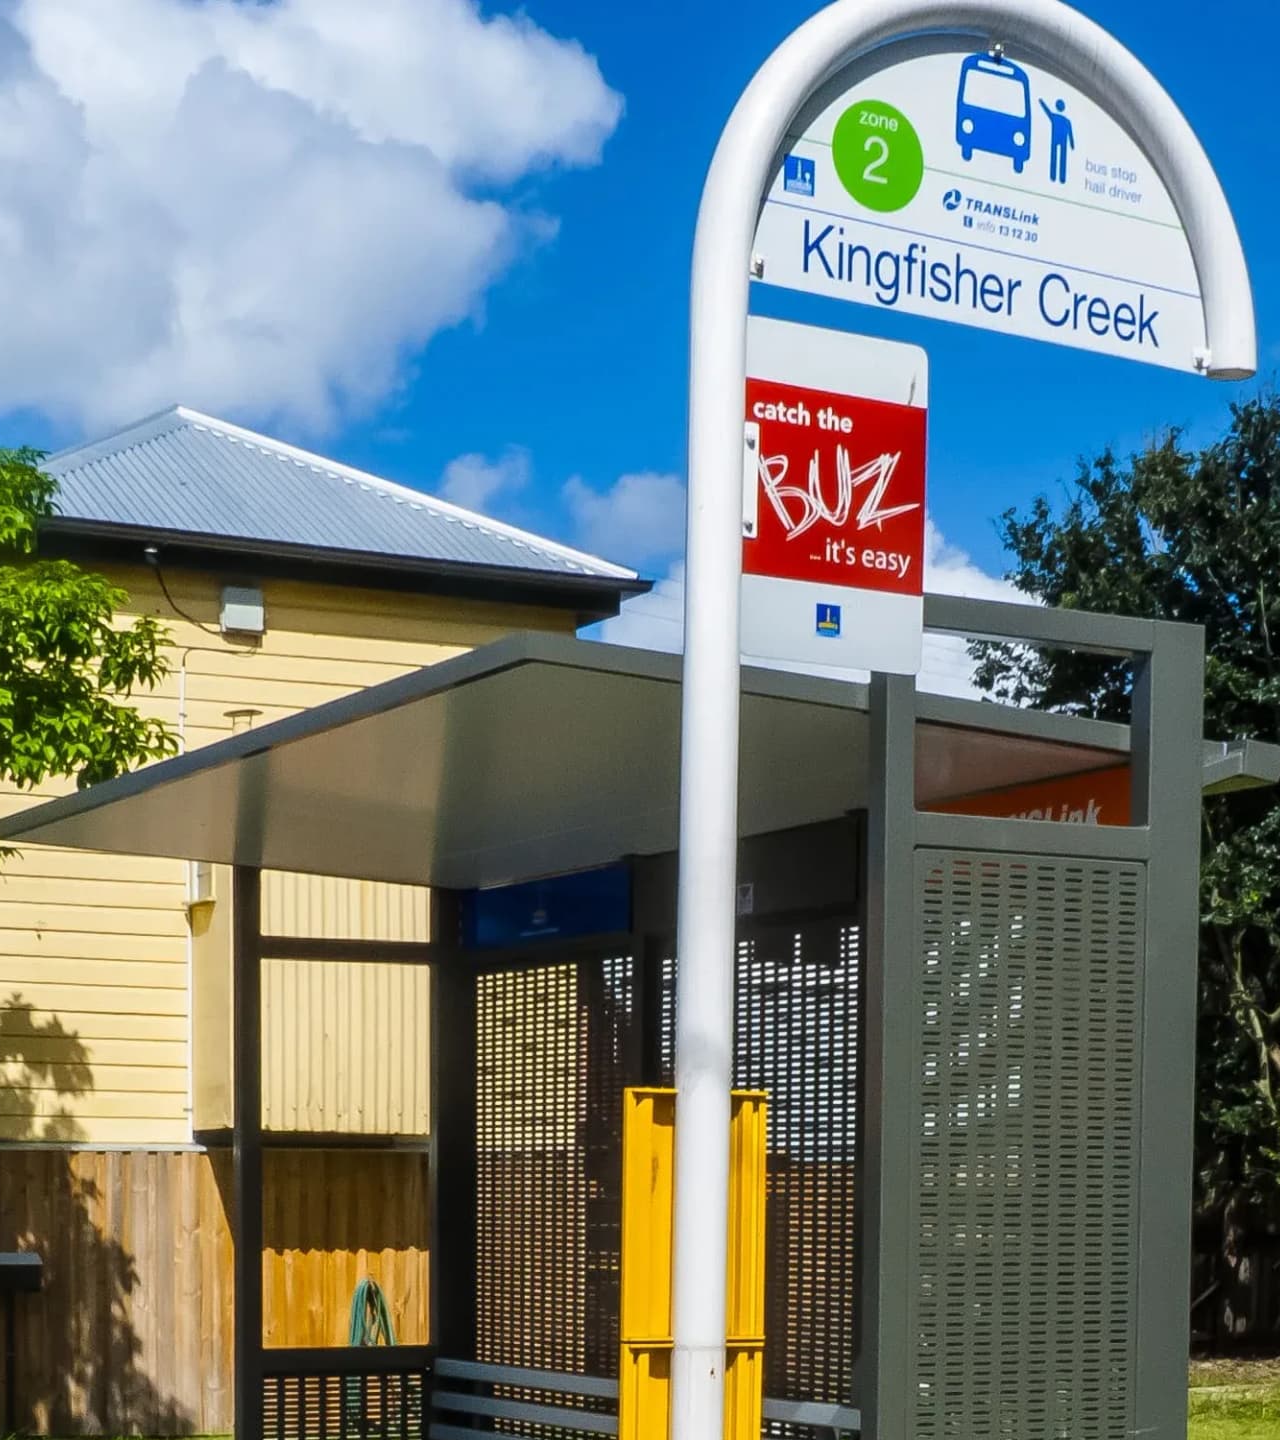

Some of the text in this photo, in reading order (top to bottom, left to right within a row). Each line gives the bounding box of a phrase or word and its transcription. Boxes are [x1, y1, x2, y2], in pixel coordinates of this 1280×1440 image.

[859, 110, 898, 132] zone
[862, 135, 889, 185] 2
[1085, 157, 1137, 184] bus stop
[1084, 177, 1143, 203] hail driver
[965, 197, 1040, 225] TRANSLink
[976, 221, 996, 233] info
[999, 225, 1010, 237] 13
[1012, 228, 1023, 240] 12
[802, 219, 1160, 348] Kingfisher Creek
[753, 401, 854, 433] catch the
[758, 443, 920, 541] BUZ
[825, 537, 856, 566] it's
[861, 548, 912, 579] easy
